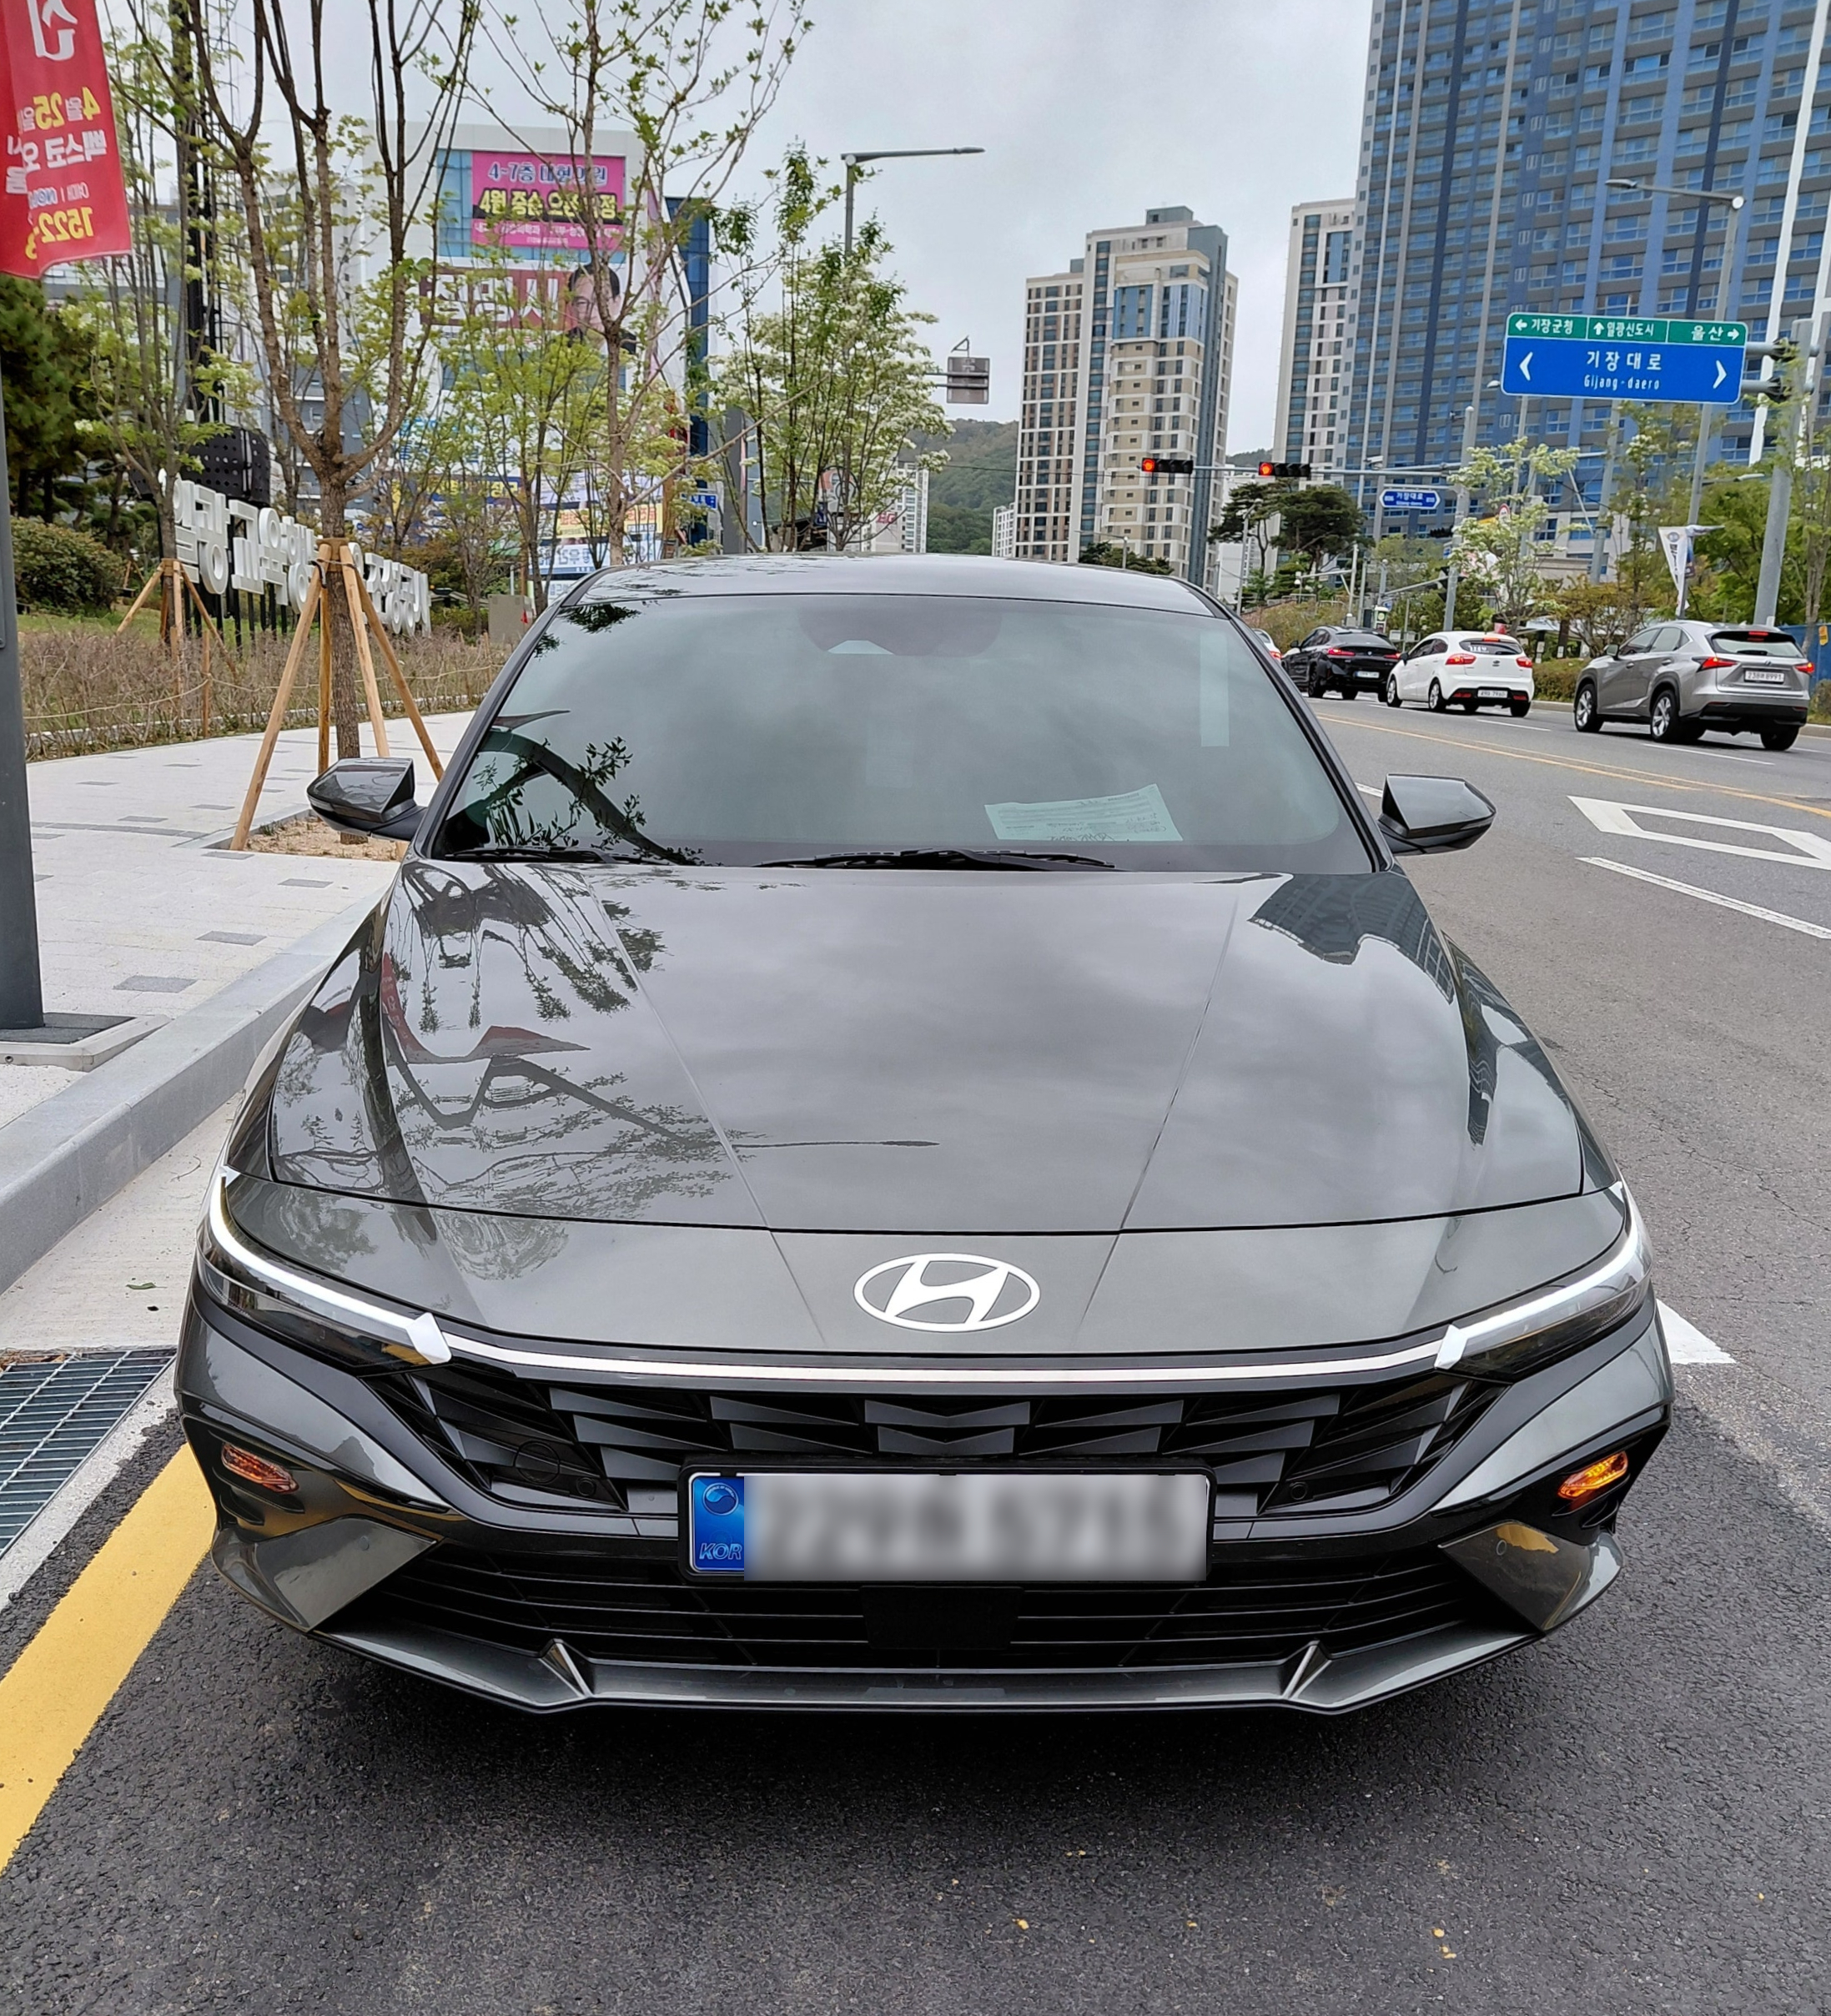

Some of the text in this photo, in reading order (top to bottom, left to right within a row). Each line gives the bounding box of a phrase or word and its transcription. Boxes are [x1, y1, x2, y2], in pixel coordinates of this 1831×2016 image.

[489, 162, 536, 182] 4~7층
[479, 188, 506, 214] 4월
[1531, 319, 1573, 334] 기장군청
[1607, 321, 1654, 337] 일광신도시
[1691, 325, 1723, 341] 울산
[1587, 350, 1662, 372] 기장대로
[699, 1542, 742, 1560] KOR
